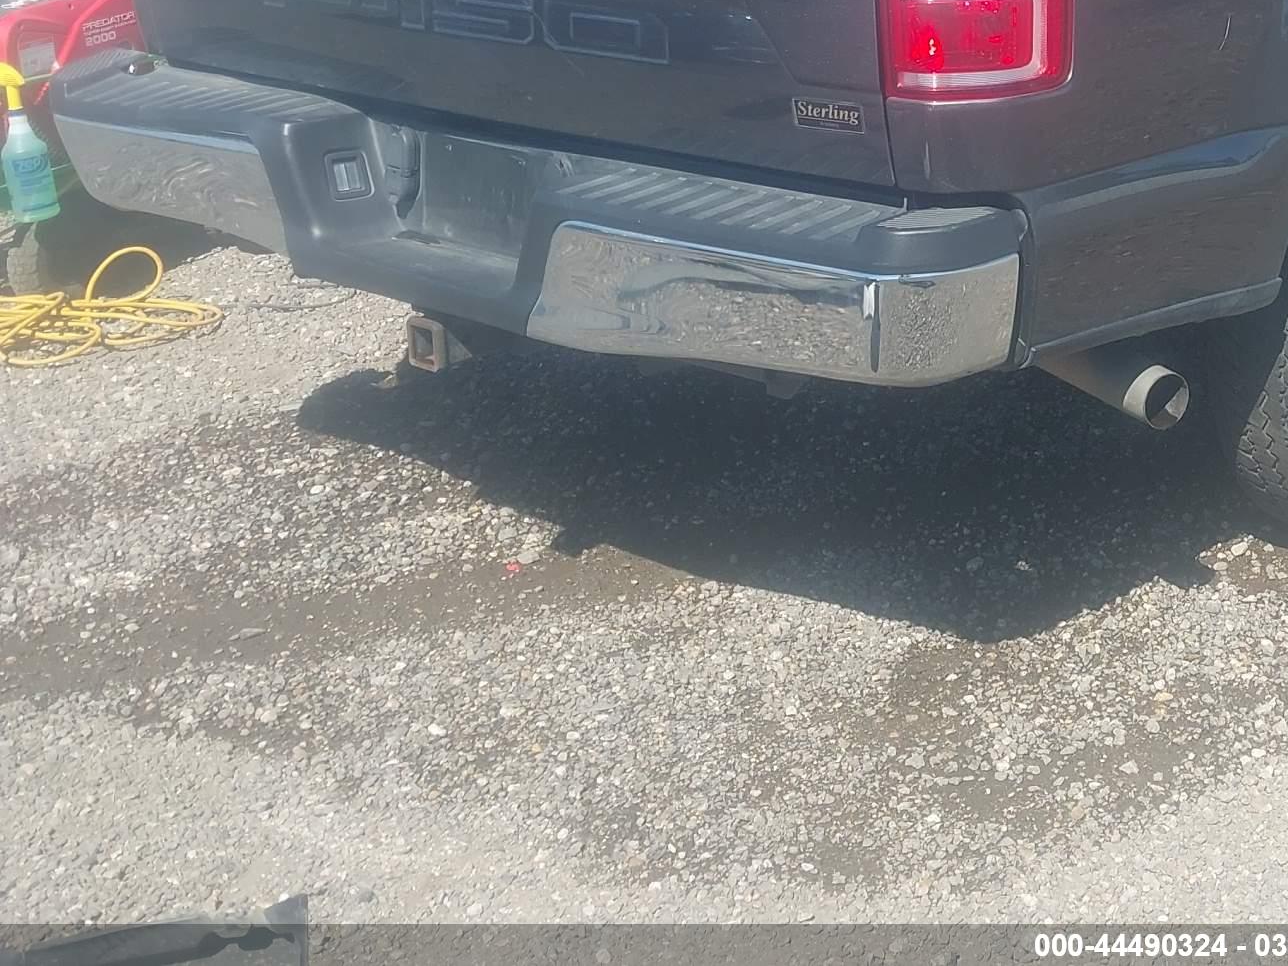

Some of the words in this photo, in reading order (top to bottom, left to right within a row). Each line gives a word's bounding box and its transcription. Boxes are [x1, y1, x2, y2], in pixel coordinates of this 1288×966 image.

[83, 11, 135, 31] PREDATOR
[86, 31, 116, 46] 2000
[798, 101, 859, 125] Sterling
